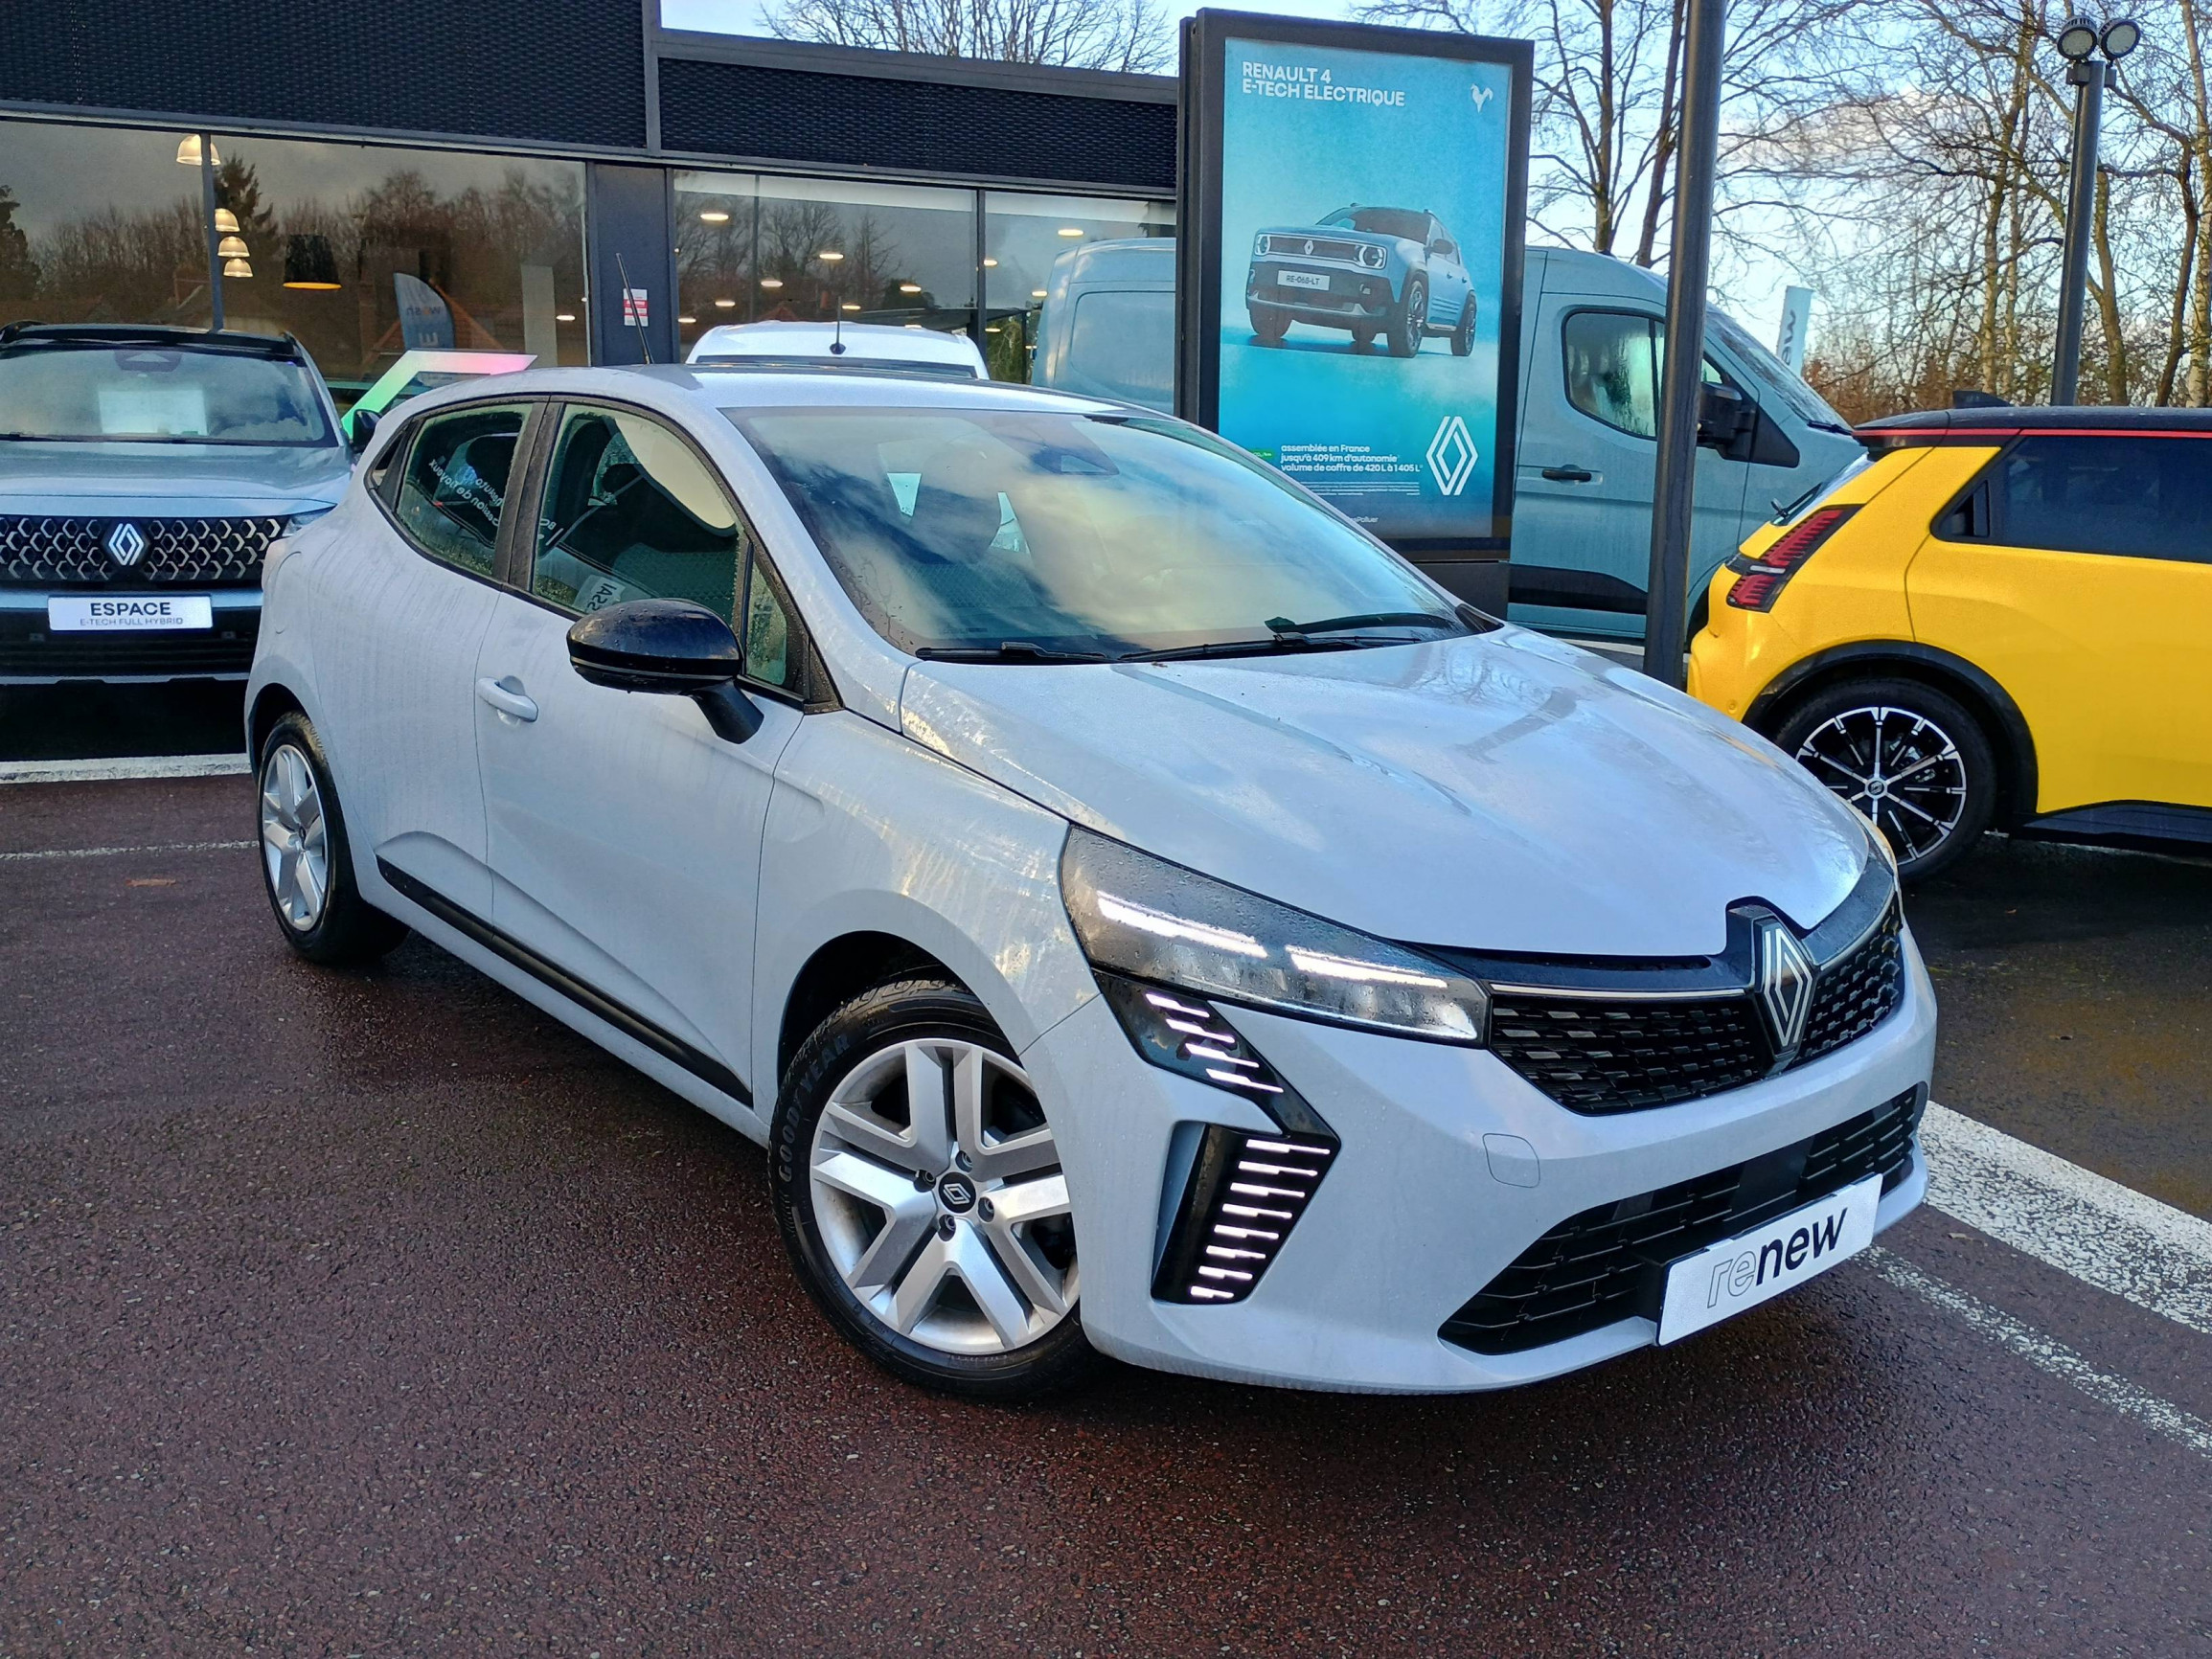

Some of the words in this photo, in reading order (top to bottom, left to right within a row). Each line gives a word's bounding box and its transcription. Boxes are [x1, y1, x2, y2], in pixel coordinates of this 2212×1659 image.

[1243, 61, 1318, 83] RENAULT
[1320, 69, 1332, 84] 4
[1243, 79, 1300, 99] E-TECH
[1304, 84, 1405, 107] ELECTRIQUE
[1281, 444, 1328, 453] assemblée
[1340, 443, 1370, 453] France
[1312, 454, 1329, 463] 409
[1329, 454, 1342, 463] km
[1281, 464, 1313, 472] volume
[1313, 464, 1325, 472] de
[1325, 464, 1352, 472] coffre
[1352, 464, 1364, 472] de
[1364, 464, 1380, 472] 420
[90, 602, 171, 617] ESPACE
[80, 617, 117, 626] E-TECH
[118, 617, 143, 626] FULL
[145, 616, 184, 625] HYBRID
[1706, 1207, 1848, 1309] renew
